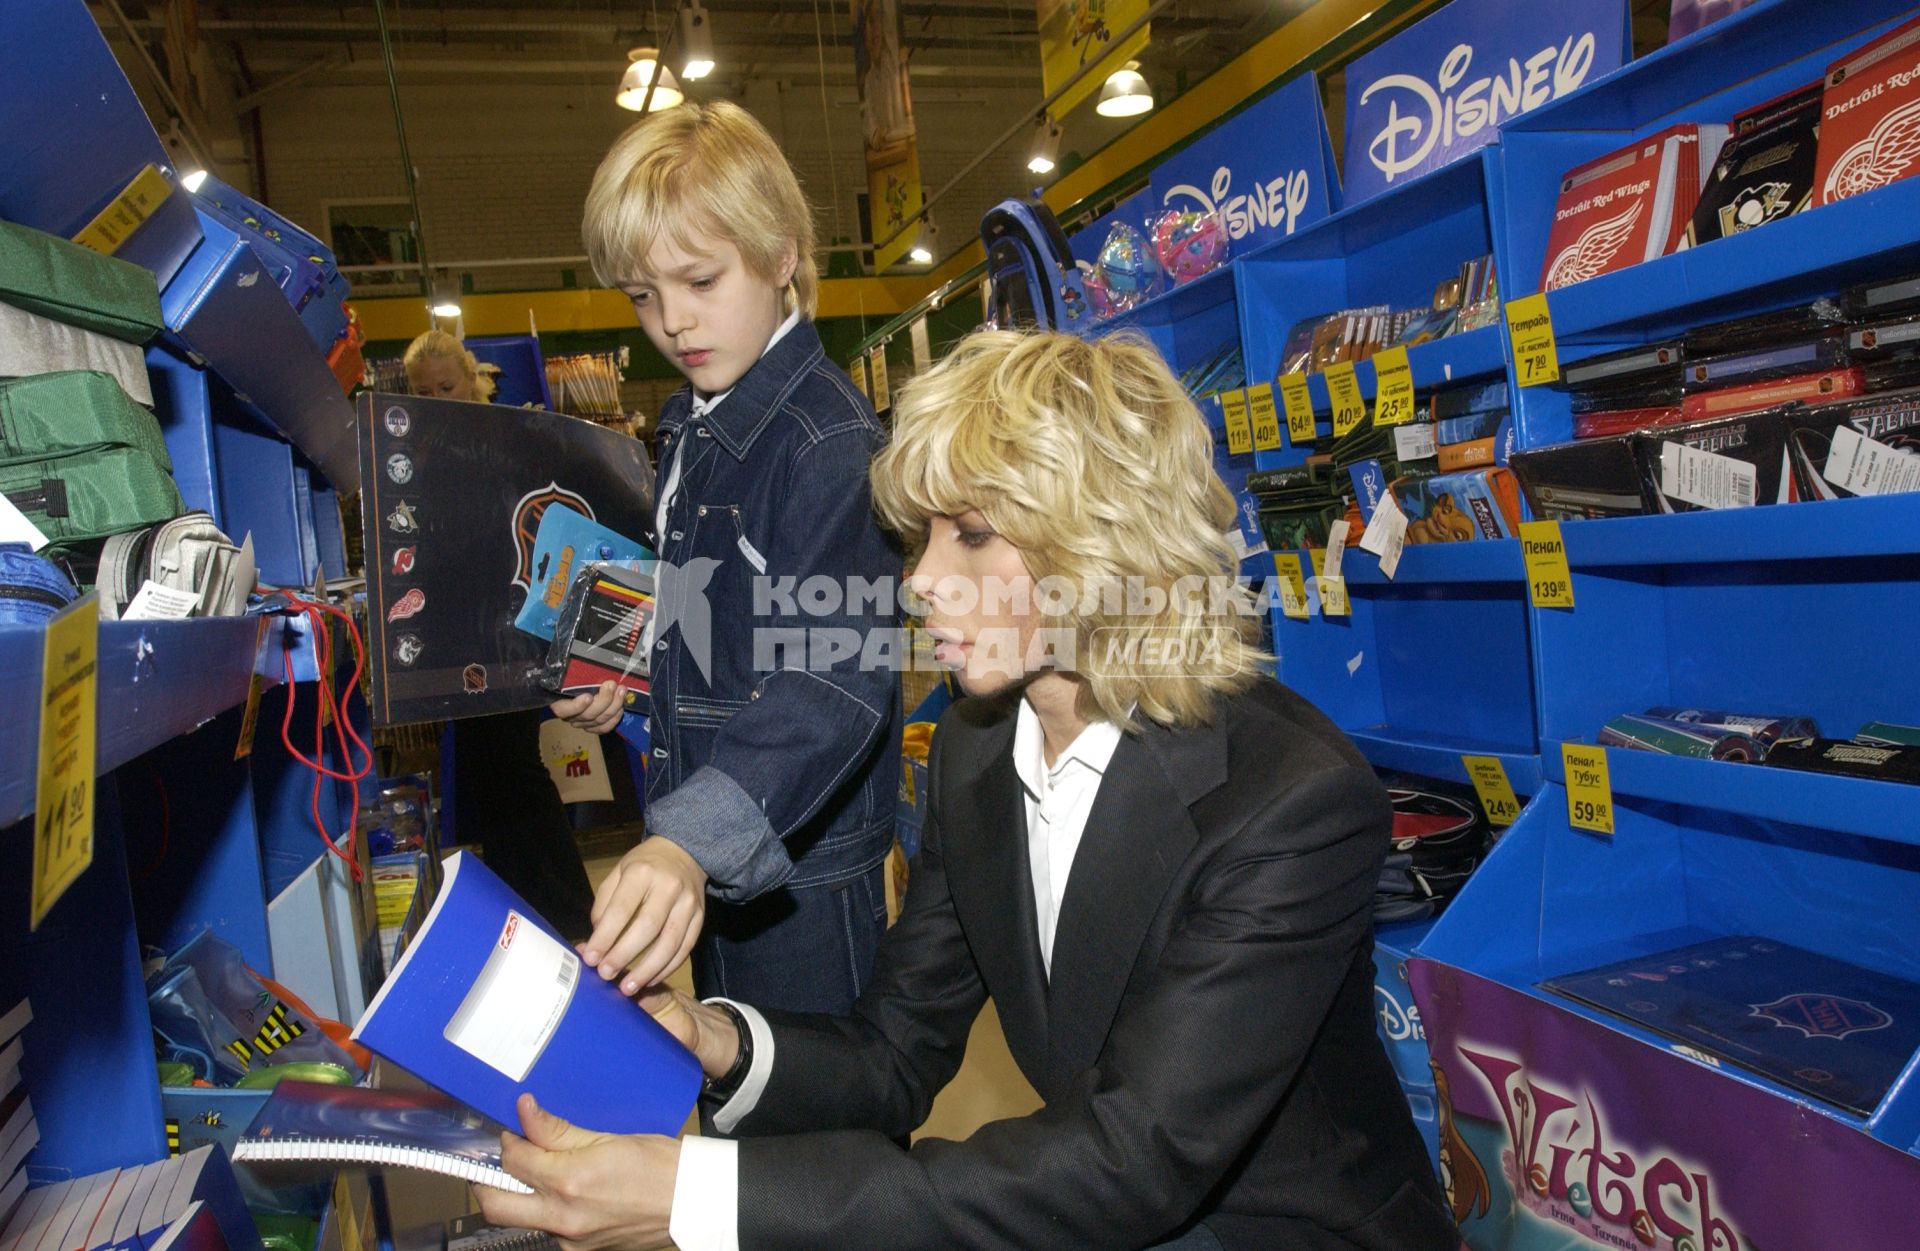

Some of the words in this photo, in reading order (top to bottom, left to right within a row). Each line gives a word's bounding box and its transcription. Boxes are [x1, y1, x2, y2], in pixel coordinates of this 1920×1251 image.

[1825, 82, 1885, 120] Detroit
[1556, 200, 1592, 221] Detroit
[1593, 190, 1615, 208] Red
[1615, 180, 1651, 199] Wings
[1510, 313, 1550, 333] Тетрадь
[1524, 540, 1562, 555] Пенал
[1566, 754, 1595, 768] Пенал
[1573, 770, 1600, 785] Тубус
[1551, 1205, 1576, 1227] Irma
